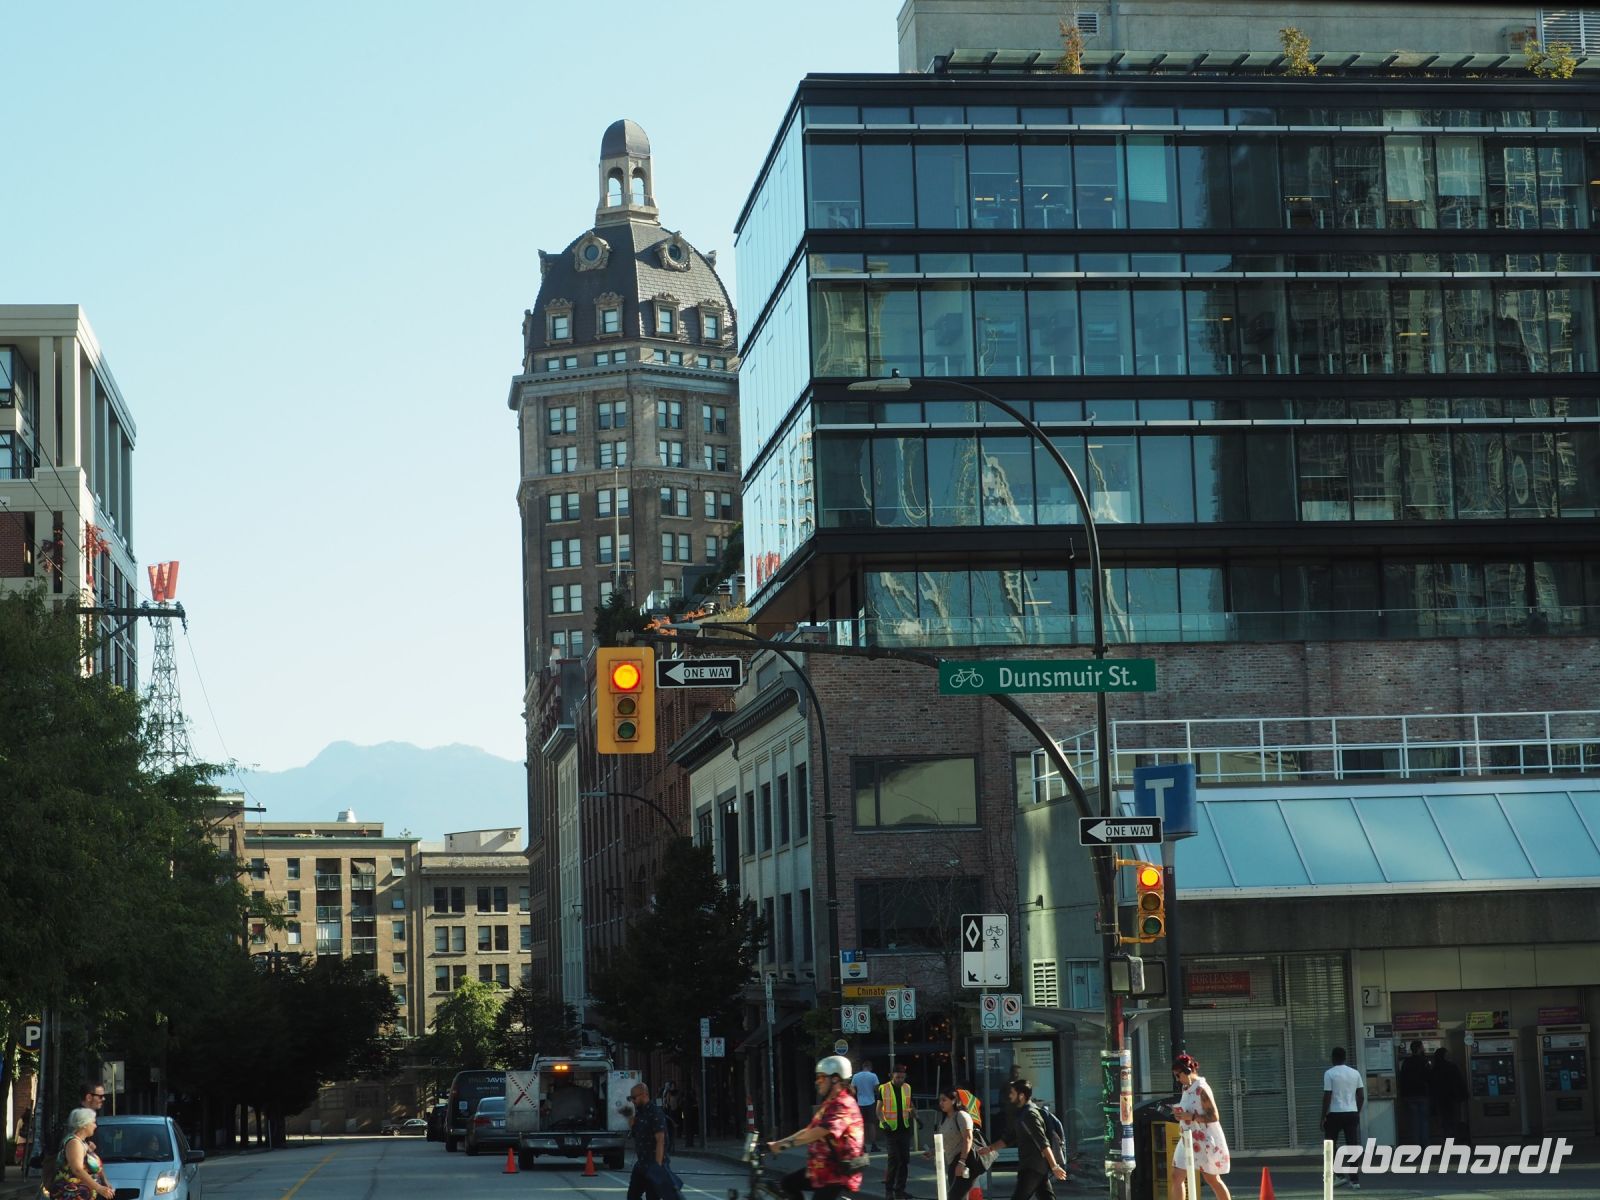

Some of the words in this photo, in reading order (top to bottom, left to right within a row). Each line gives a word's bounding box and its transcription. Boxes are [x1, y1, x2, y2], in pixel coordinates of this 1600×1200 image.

[148, 560, 180, 602] W
[683, 668, 705, 678] ONE
[709, 668, 731, 678] WAY
[999, 665, 1103, 688] Dunsmuir
[1108, 665, 1138, 687] St.
[1145, 777, 1175, 820] T
[1105, 826, 1127, 836] ONE
[1130, 825, 1152, 836] WAY
[857, 986, 885, 996] Chinato
[25, 1025, 41, 1047] P
